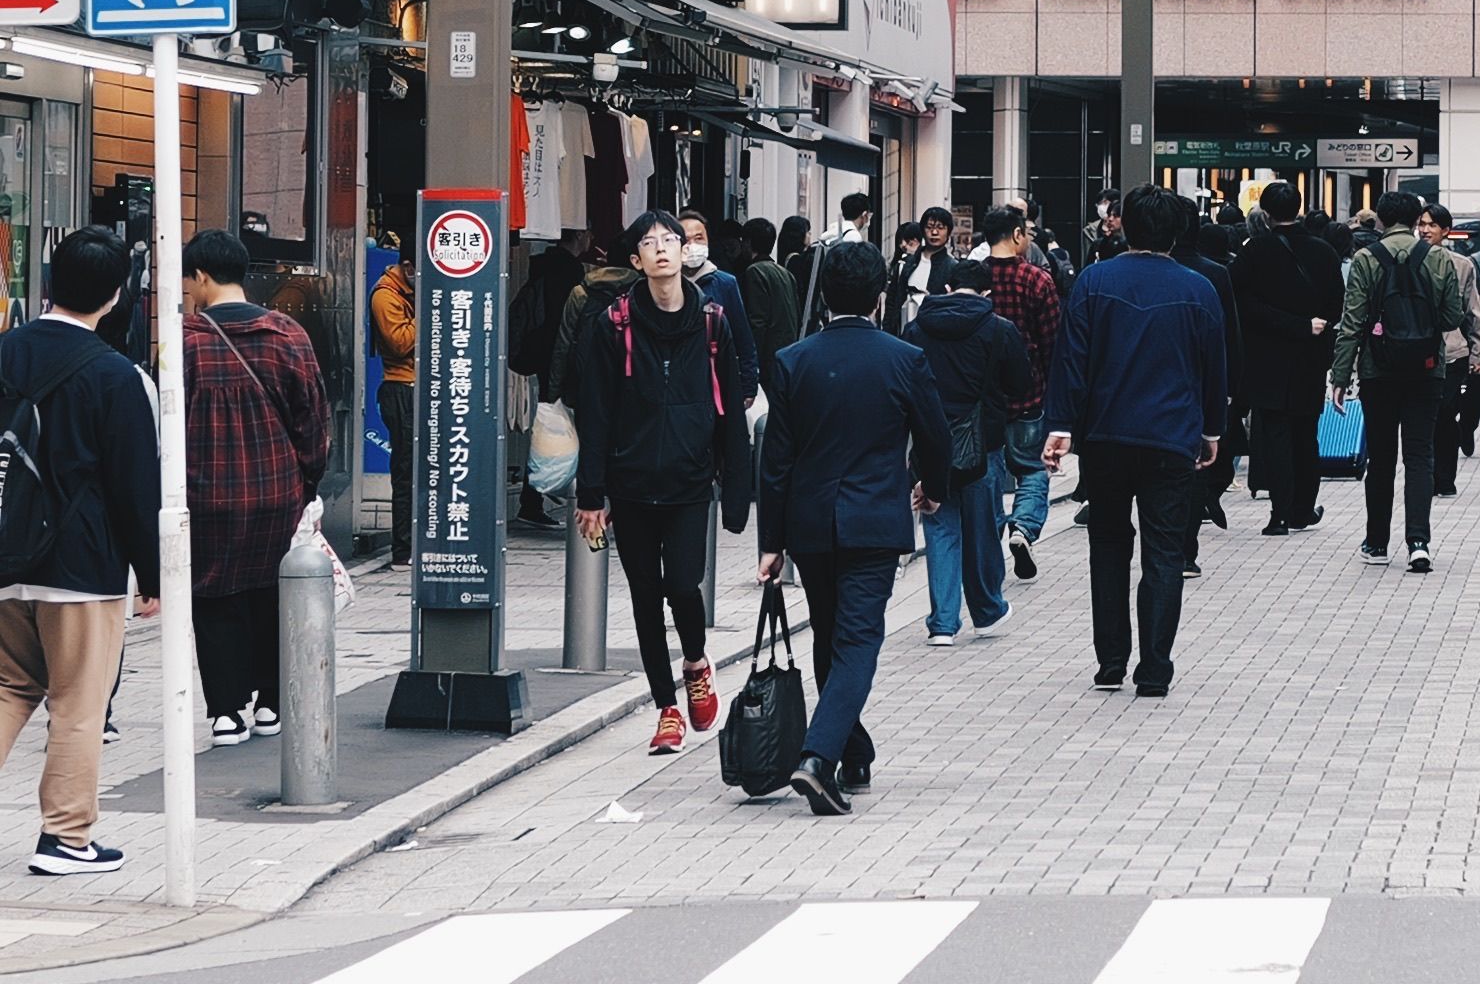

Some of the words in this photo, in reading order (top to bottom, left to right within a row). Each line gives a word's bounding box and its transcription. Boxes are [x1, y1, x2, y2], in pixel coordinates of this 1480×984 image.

[438, 232, 482, 249] 客引き
[434, 249, 486, 262] Solicitation
[432, 289, 443, 306] No
[430, 381, 441, 398] No
[429, 470, 440, 487] No
[426, 490, 438, 539] scouting
